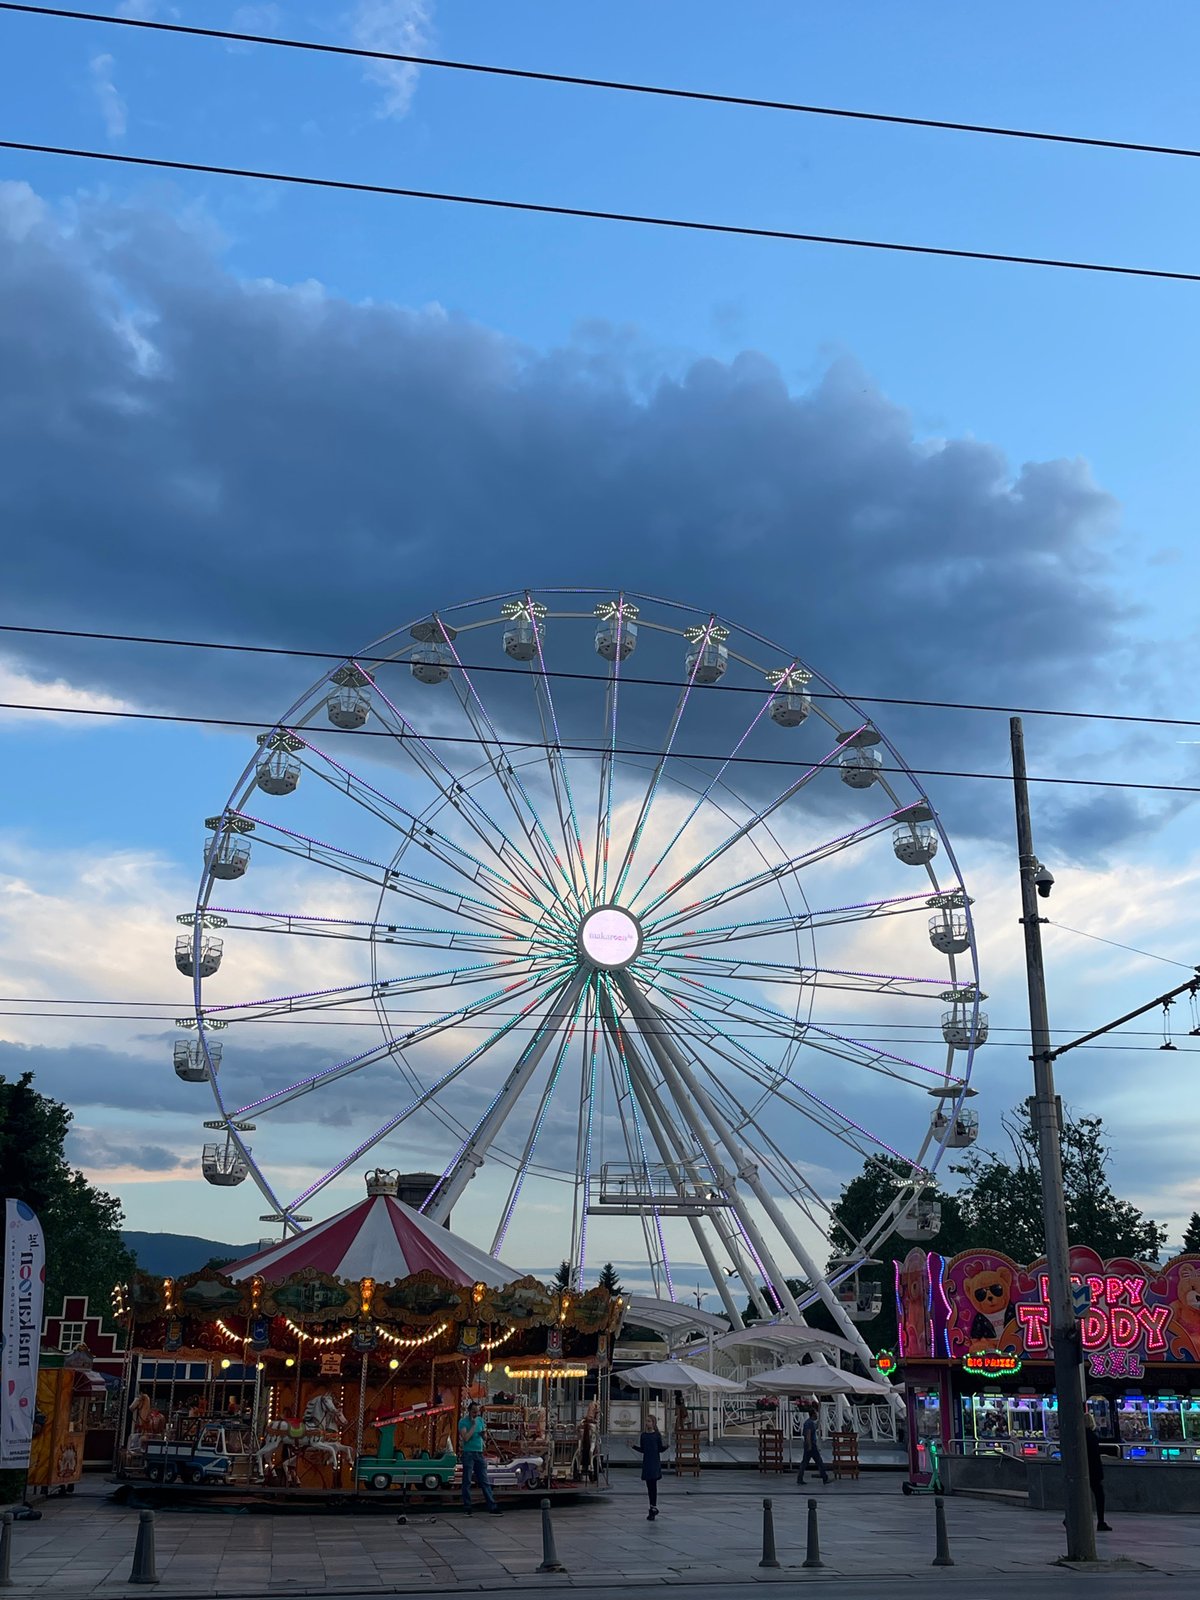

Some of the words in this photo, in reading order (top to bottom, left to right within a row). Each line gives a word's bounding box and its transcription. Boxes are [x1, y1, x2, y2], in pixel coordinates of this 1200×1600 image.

[1018, 1306, 1170, 1349] TDDY
[967, 1357, 983, 1367] BIG
[984, 1357, 1016, 1368] PRIZES
[1089, 1350, 1144, 1378] XXL
